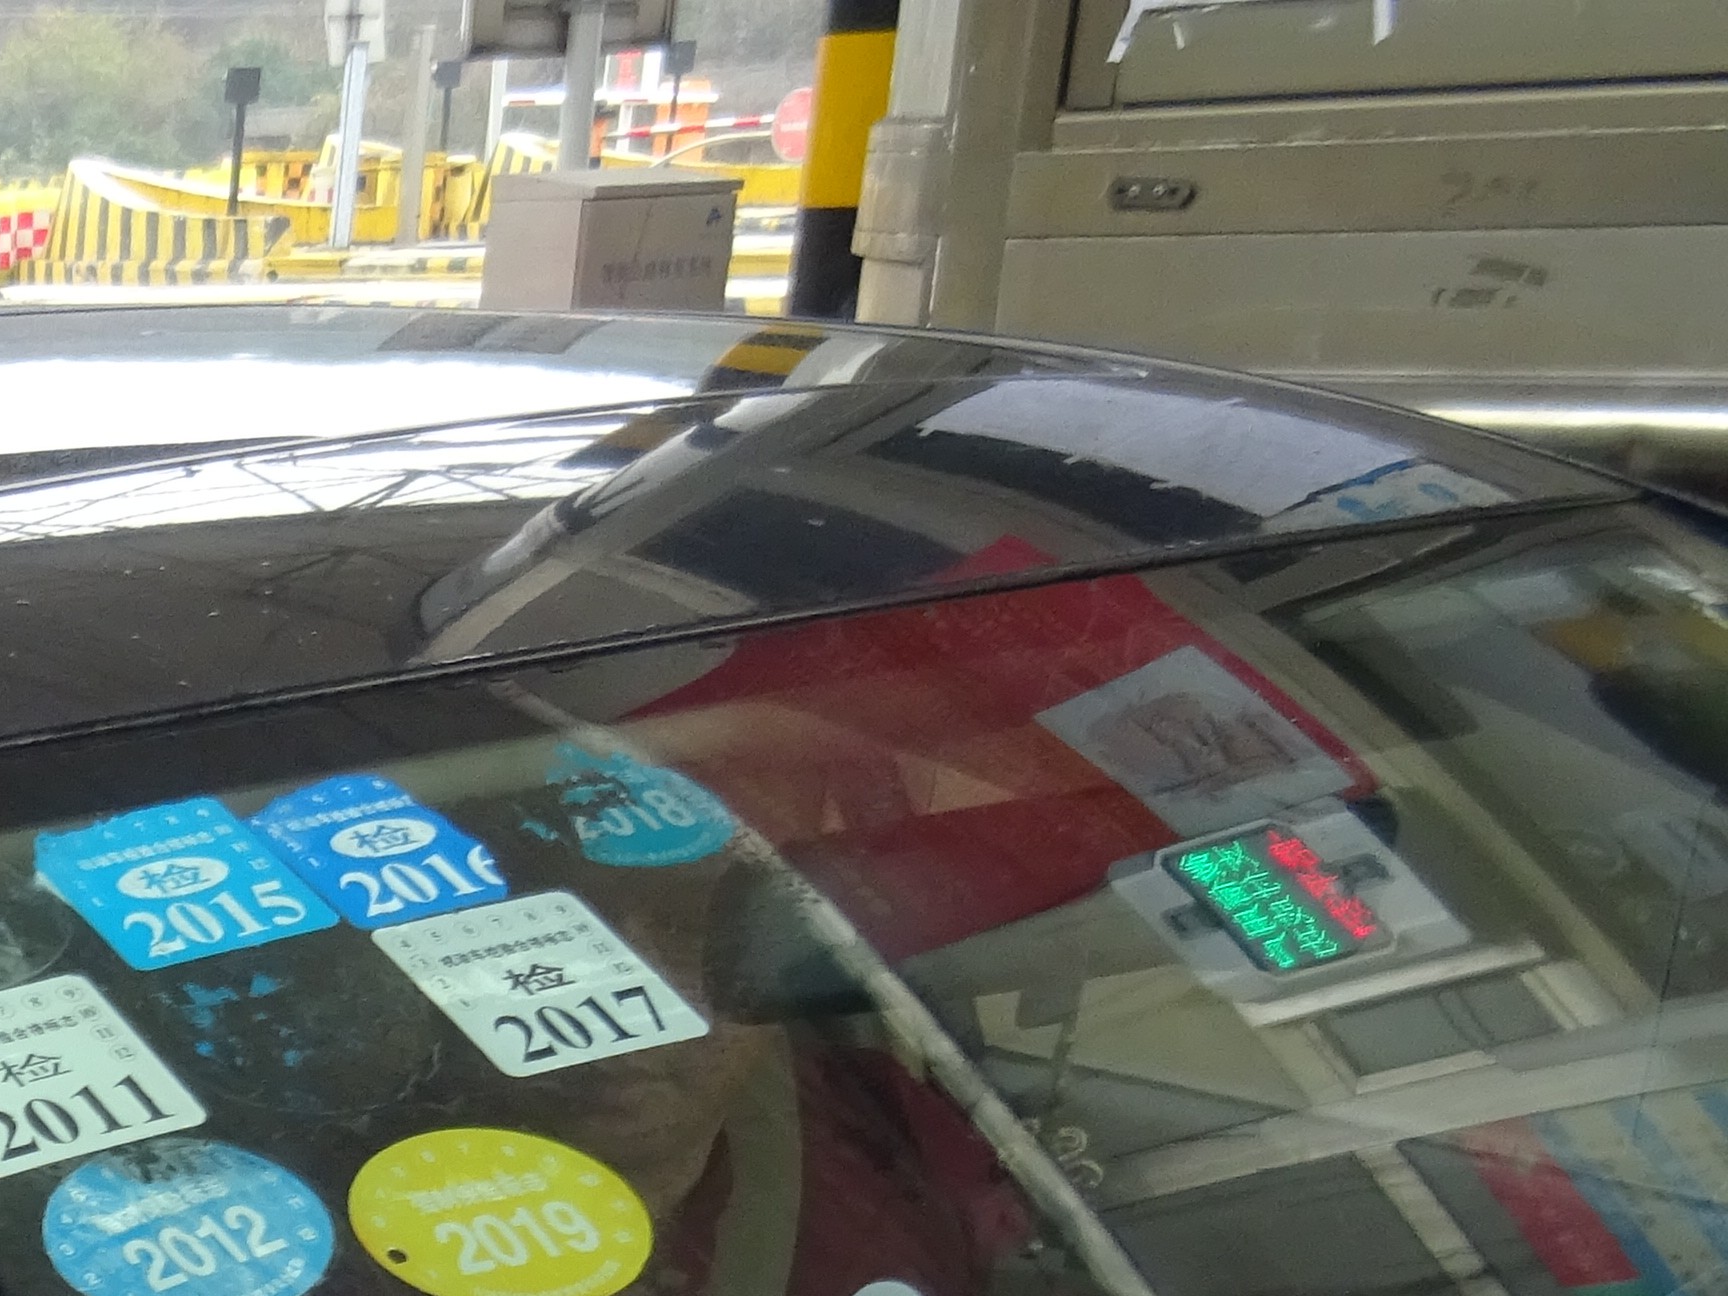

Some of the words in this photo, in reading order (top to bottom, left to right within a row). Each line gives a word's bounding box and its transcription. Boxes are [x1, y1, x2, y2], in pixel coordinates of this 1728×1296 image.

[349, 824, 419, 853] 检
[138, 864, 211, 894] 检
[123, 880, 308, 958] 2015
[501, 963, 575, 996] 检
[493, 985, 666, 1063] 2017
[122, 1205, 290, 1292] 2012
[434, 1200, 600, 1276] 2019
